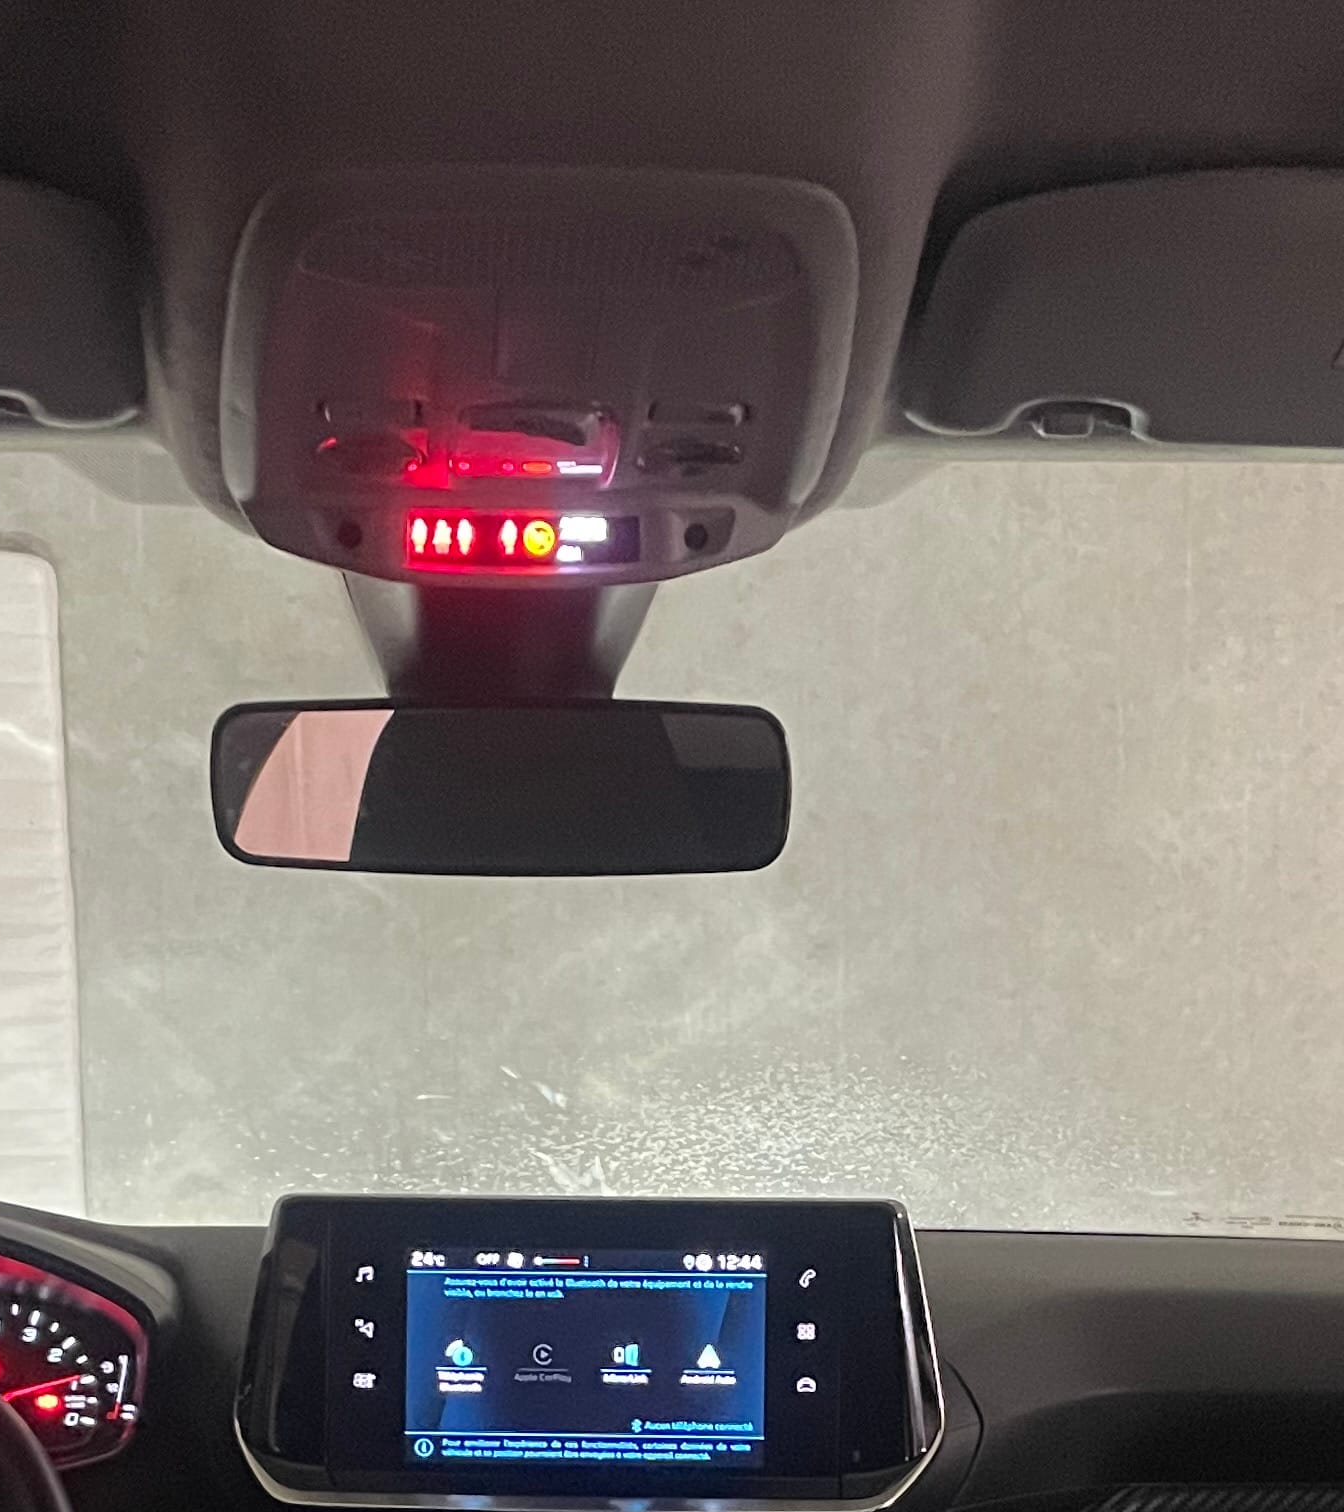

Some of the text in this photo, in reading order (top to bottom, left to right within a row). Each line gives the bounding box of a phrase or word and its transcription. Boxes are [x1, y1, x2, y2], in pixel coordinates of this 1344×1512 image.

[717, 1254, 763, 1270] 12:44
[21, 1327, 38, 1343] 3
[47, 1348, 63, 1363] 2
[64, 1412, 79, 1427] 0
